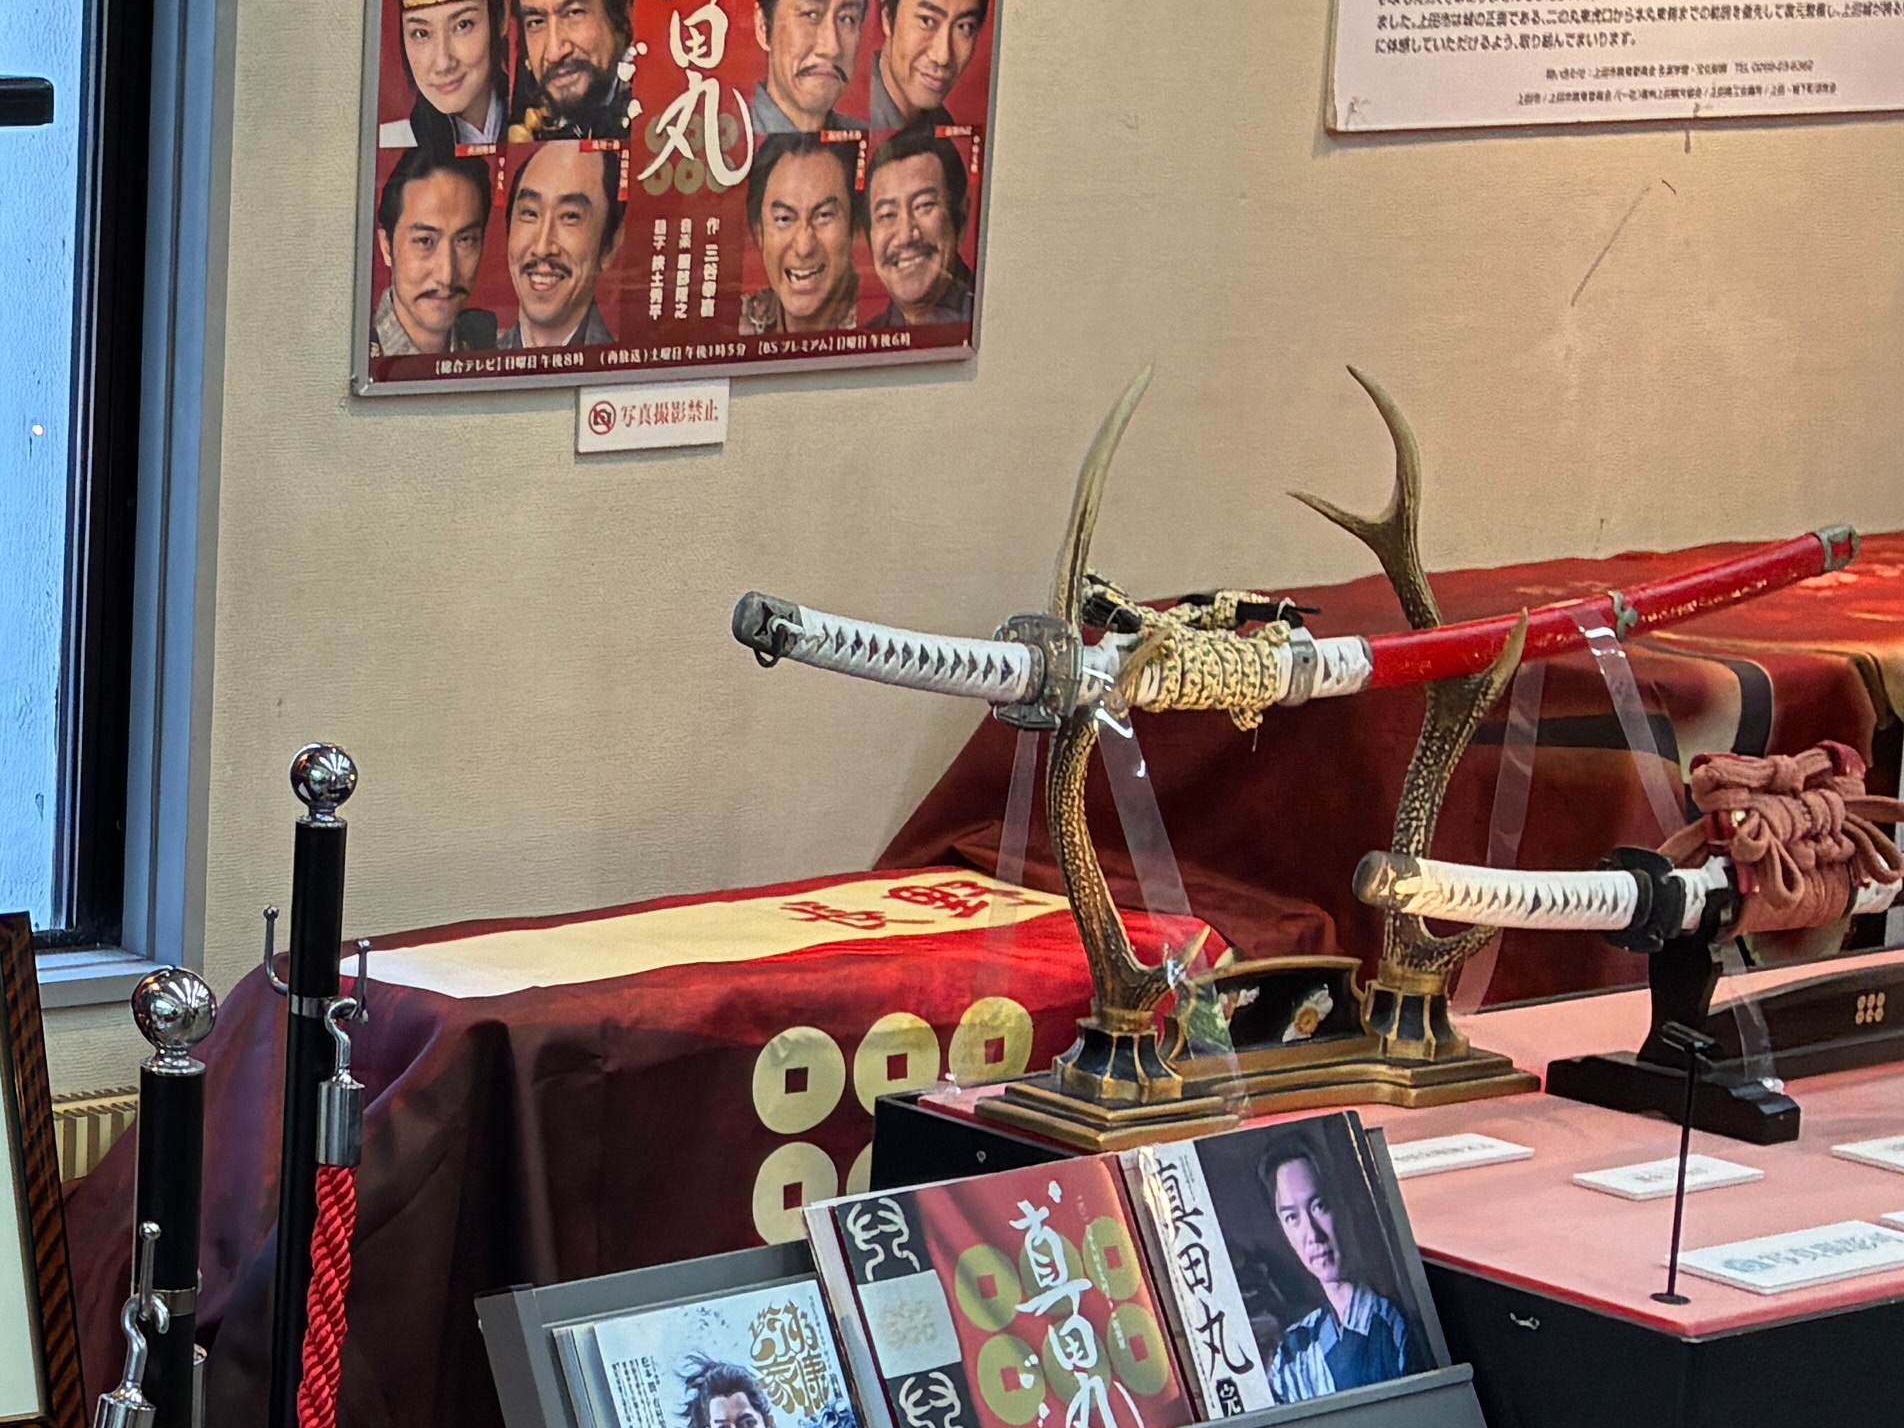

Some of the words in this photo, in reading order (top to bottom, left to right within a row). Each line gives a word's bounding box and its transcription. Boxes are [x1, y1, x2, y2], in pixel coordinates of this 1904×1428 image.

[620, 397, 718, 429] 写真撮影禁止
